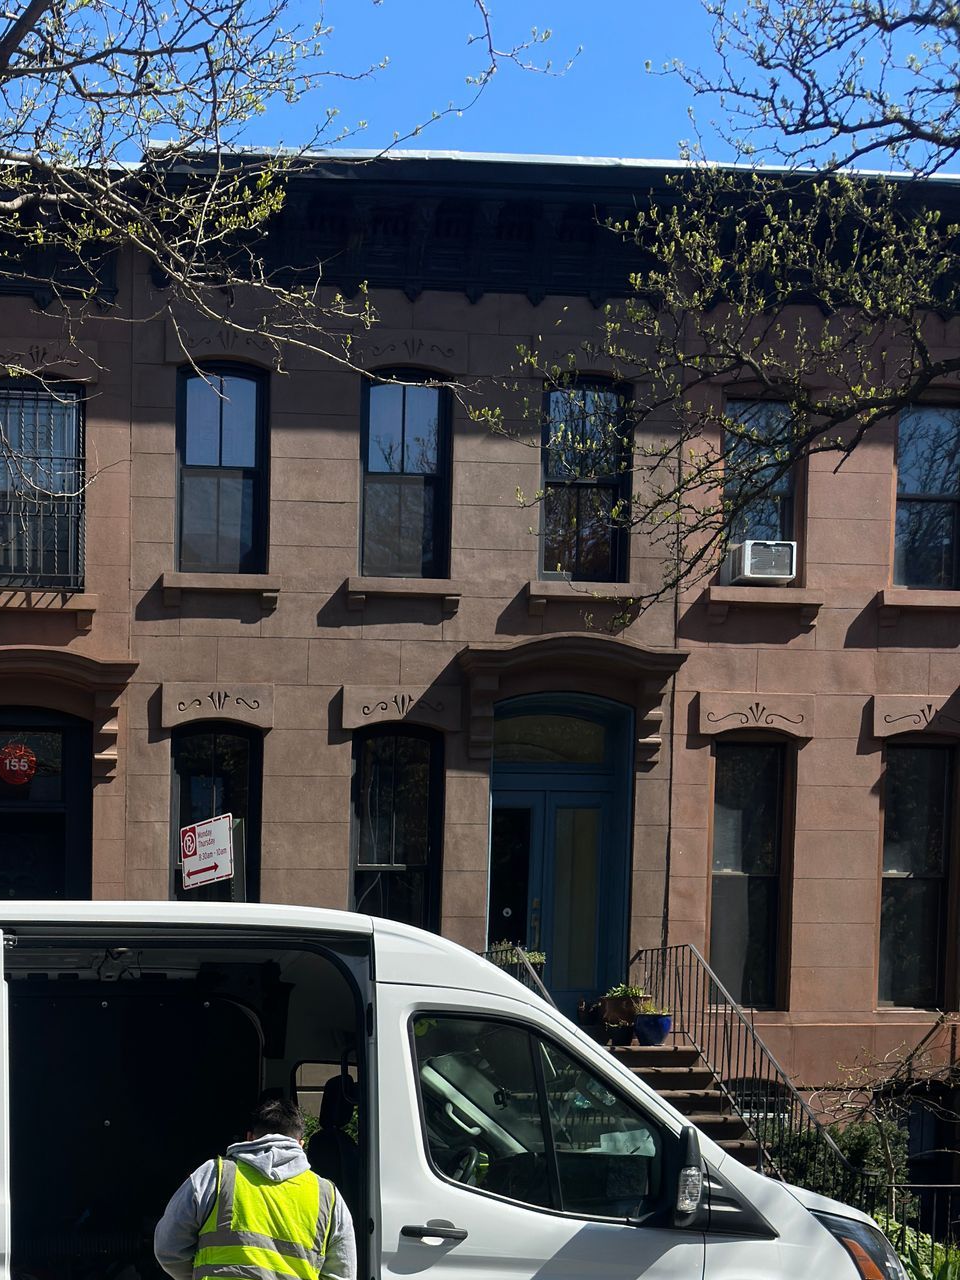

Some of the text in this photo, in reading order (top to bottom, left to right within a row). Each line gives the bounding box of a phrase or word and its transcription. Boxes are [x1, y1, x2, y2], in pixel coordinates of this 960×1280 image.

[5, 758, 29, 770] 155
[197, 829, 212, 839] Monday
[198, 838, 215, 848] Thursday
